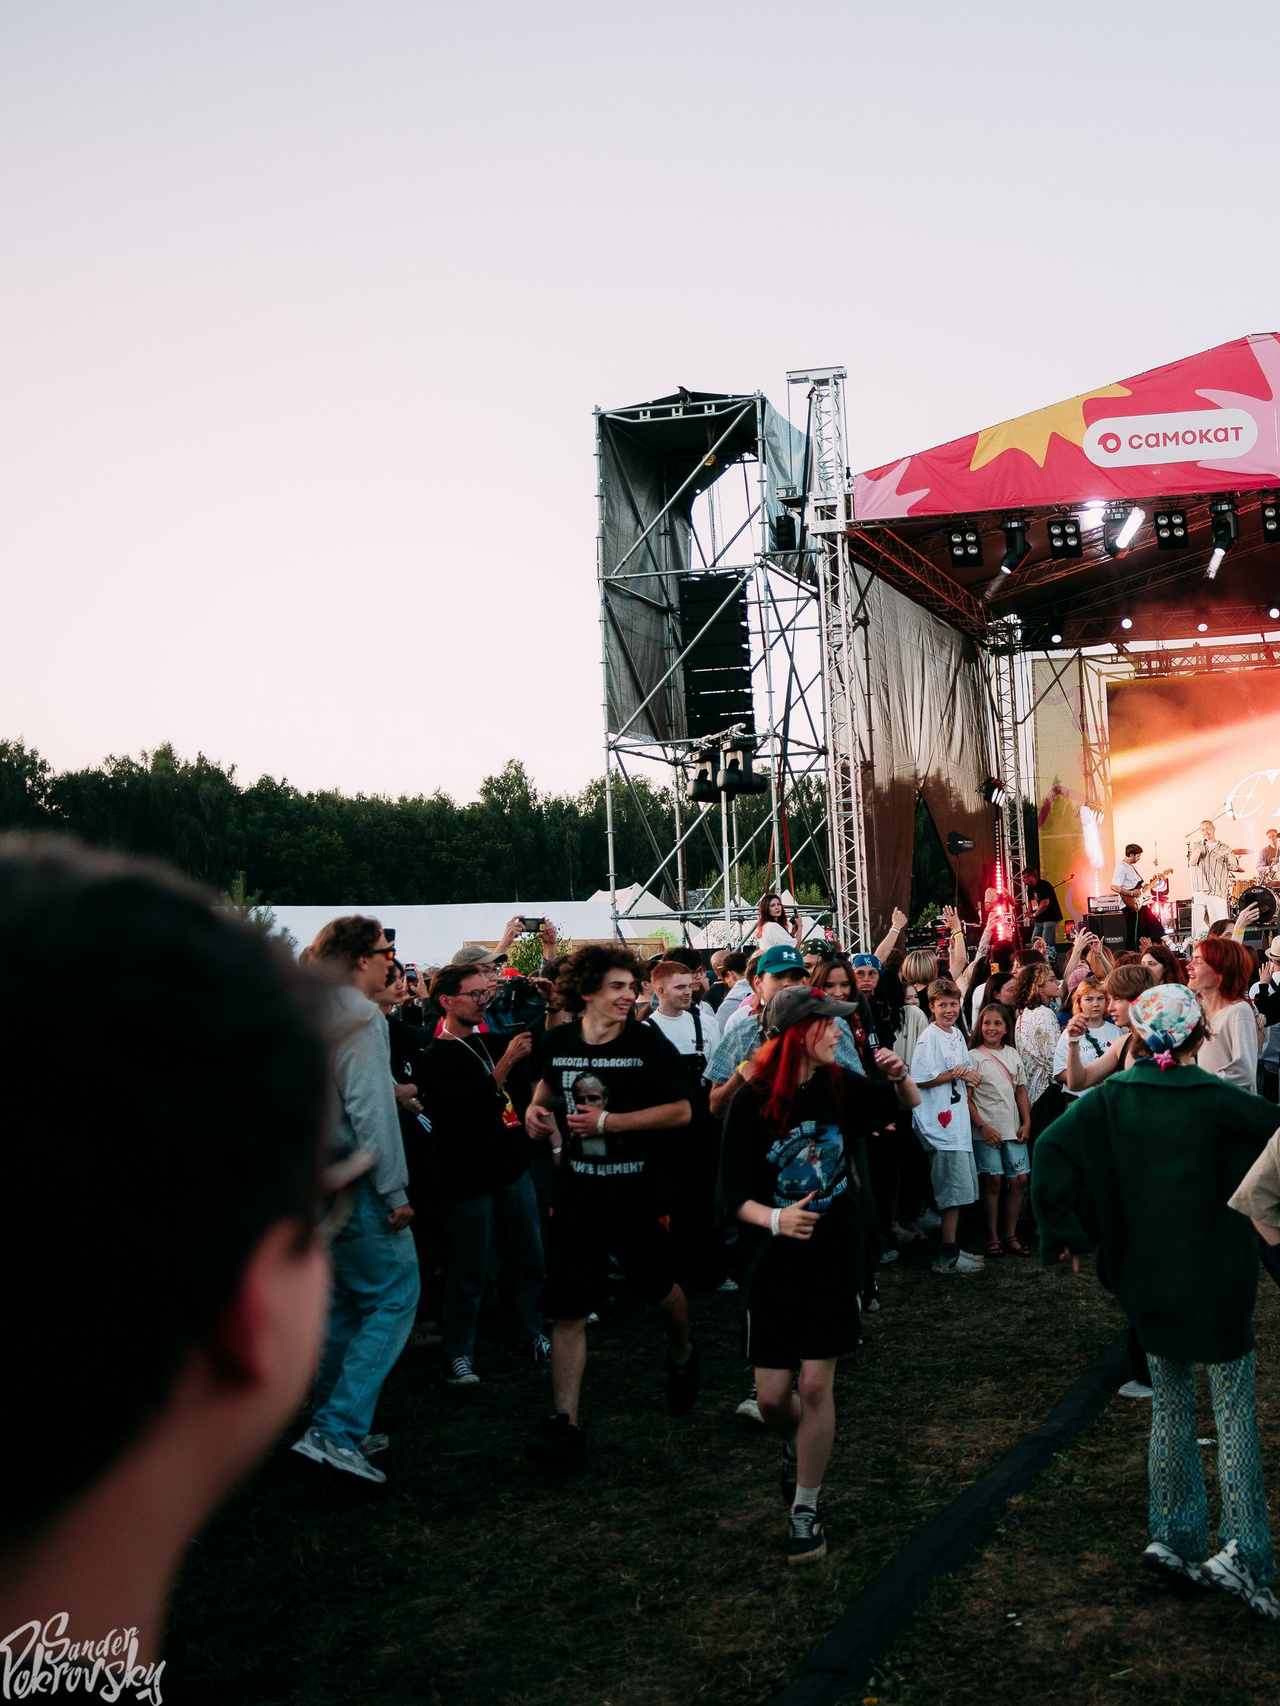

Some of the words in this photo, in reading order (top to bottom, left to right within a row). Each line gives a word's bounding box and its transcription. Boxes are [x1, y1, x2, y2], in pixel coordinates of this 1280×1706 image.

[552, 1057, 589, 1067] НЕКОГДА
[591, 1058, 644, 1068] ОБЪЯСНЯТЬ
[597, 1161, 645, 1176] ЦЕМЕНТ
